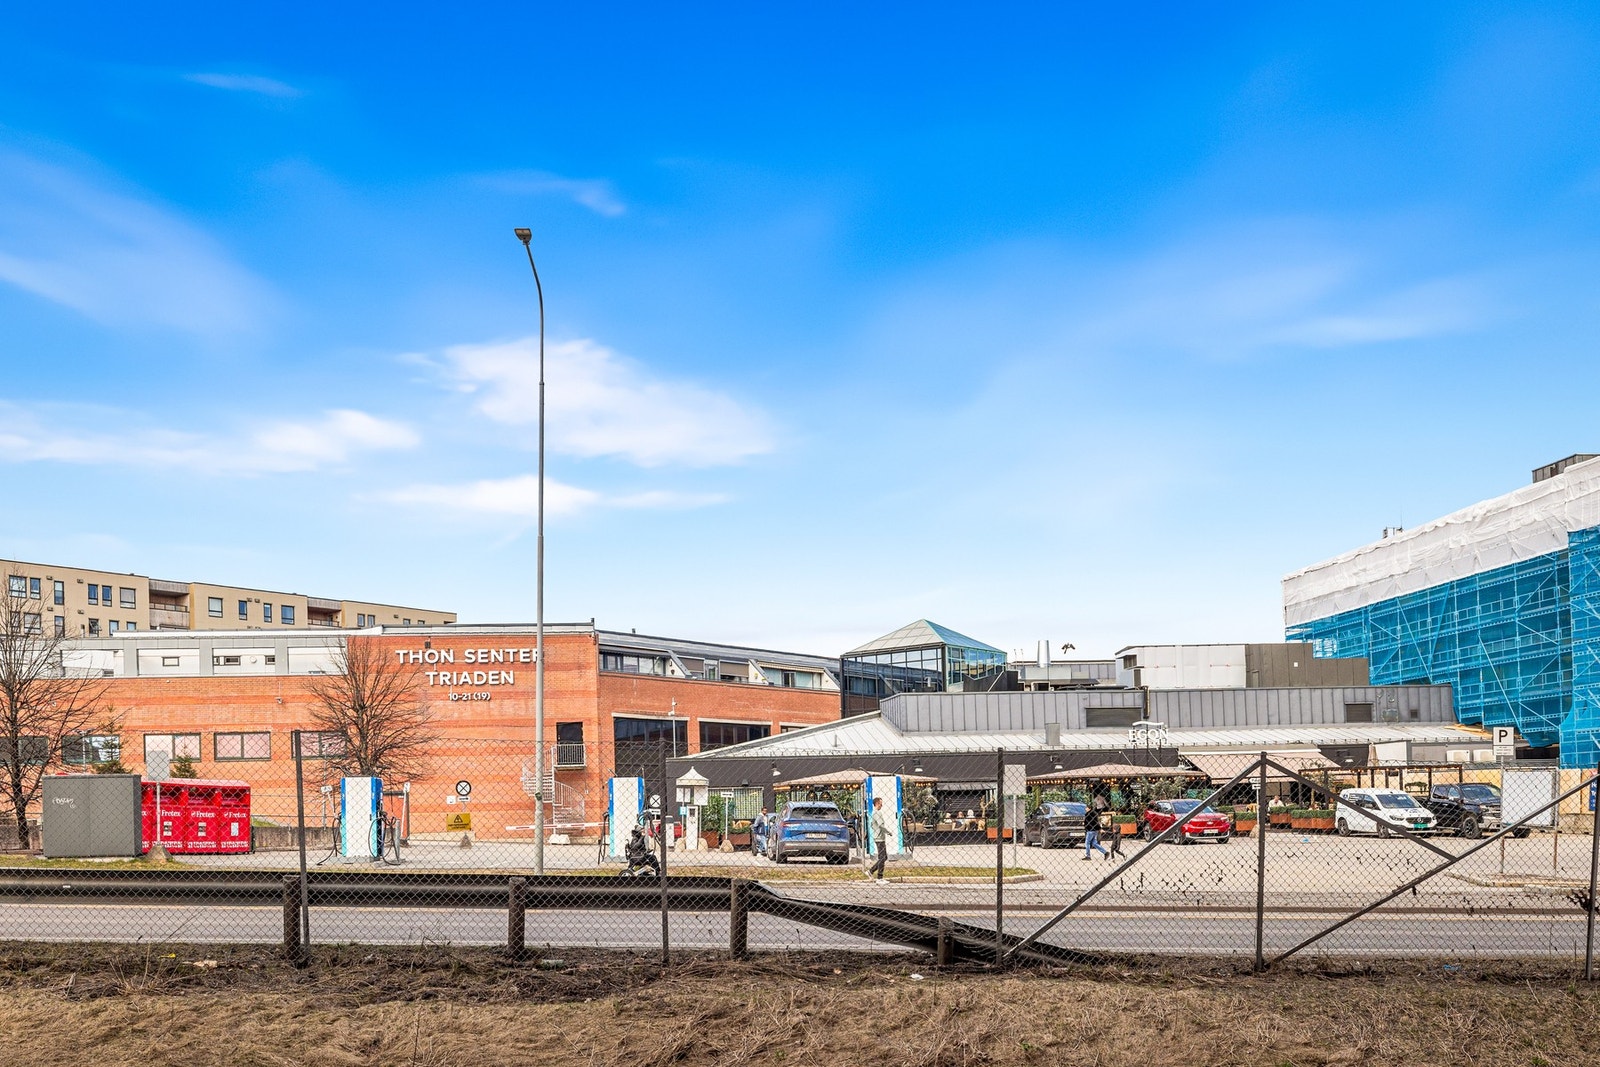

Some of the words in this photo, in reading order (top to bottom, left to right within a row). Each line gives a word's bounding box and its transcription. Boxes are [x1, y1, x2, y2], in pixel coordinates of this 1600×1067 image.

[395, 649, 454, 664] THON
[425, 670, 514, 686] TRIADEN
[448, 692, 471, 701] 10-21
[473, 691, 491, 701] (19)
[1128, 729, 1168, 741] EGON
[1499, 730, 1508, 742] P
